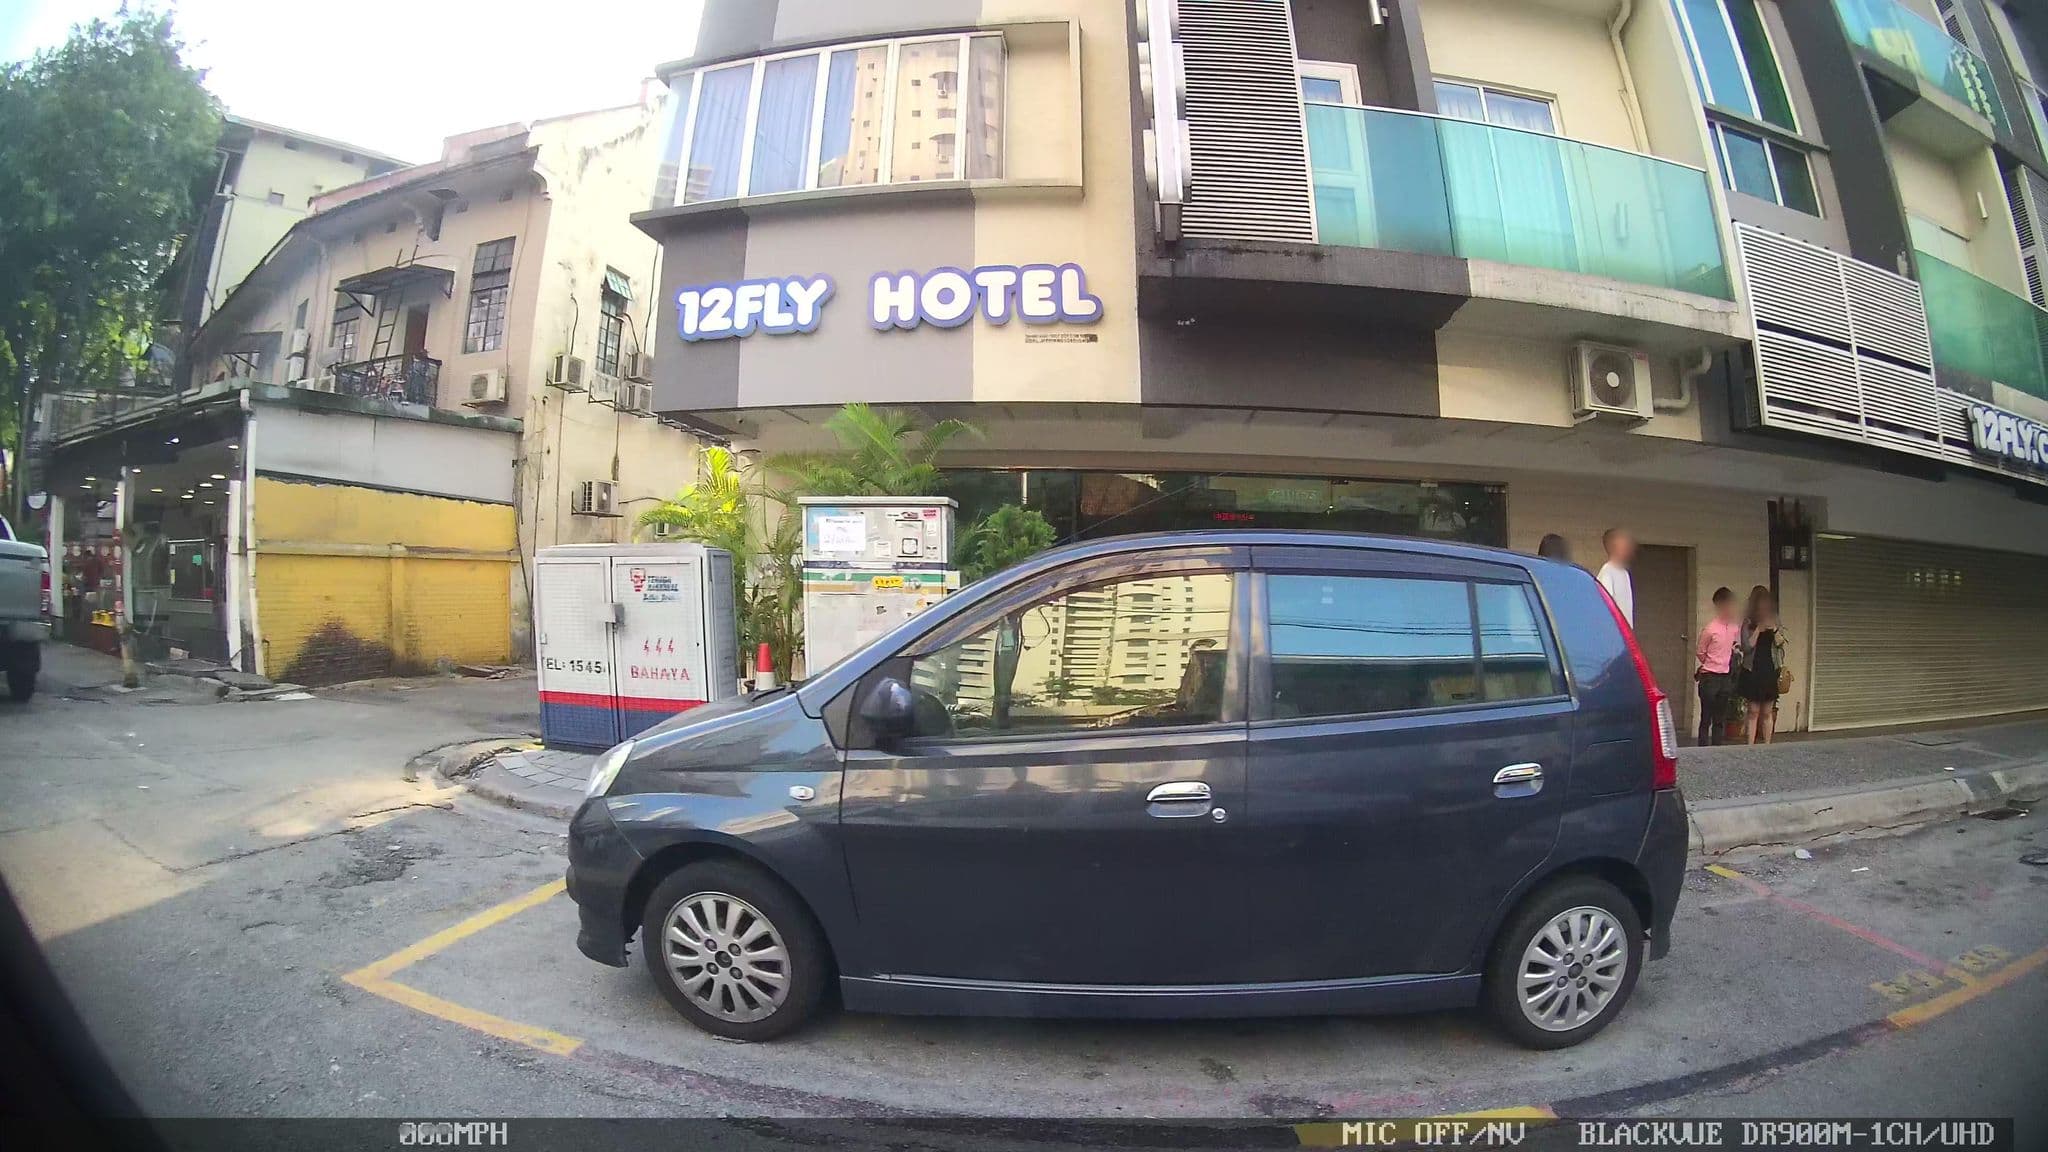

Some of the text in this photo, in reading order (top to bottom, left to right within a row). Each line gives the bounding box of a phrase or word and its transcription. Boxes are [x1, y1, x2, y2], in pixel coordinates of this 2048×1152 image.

[675, 263, 1104, 342] 12FLY HOTEL
[631, 665, 690, 681] BAHAYA
